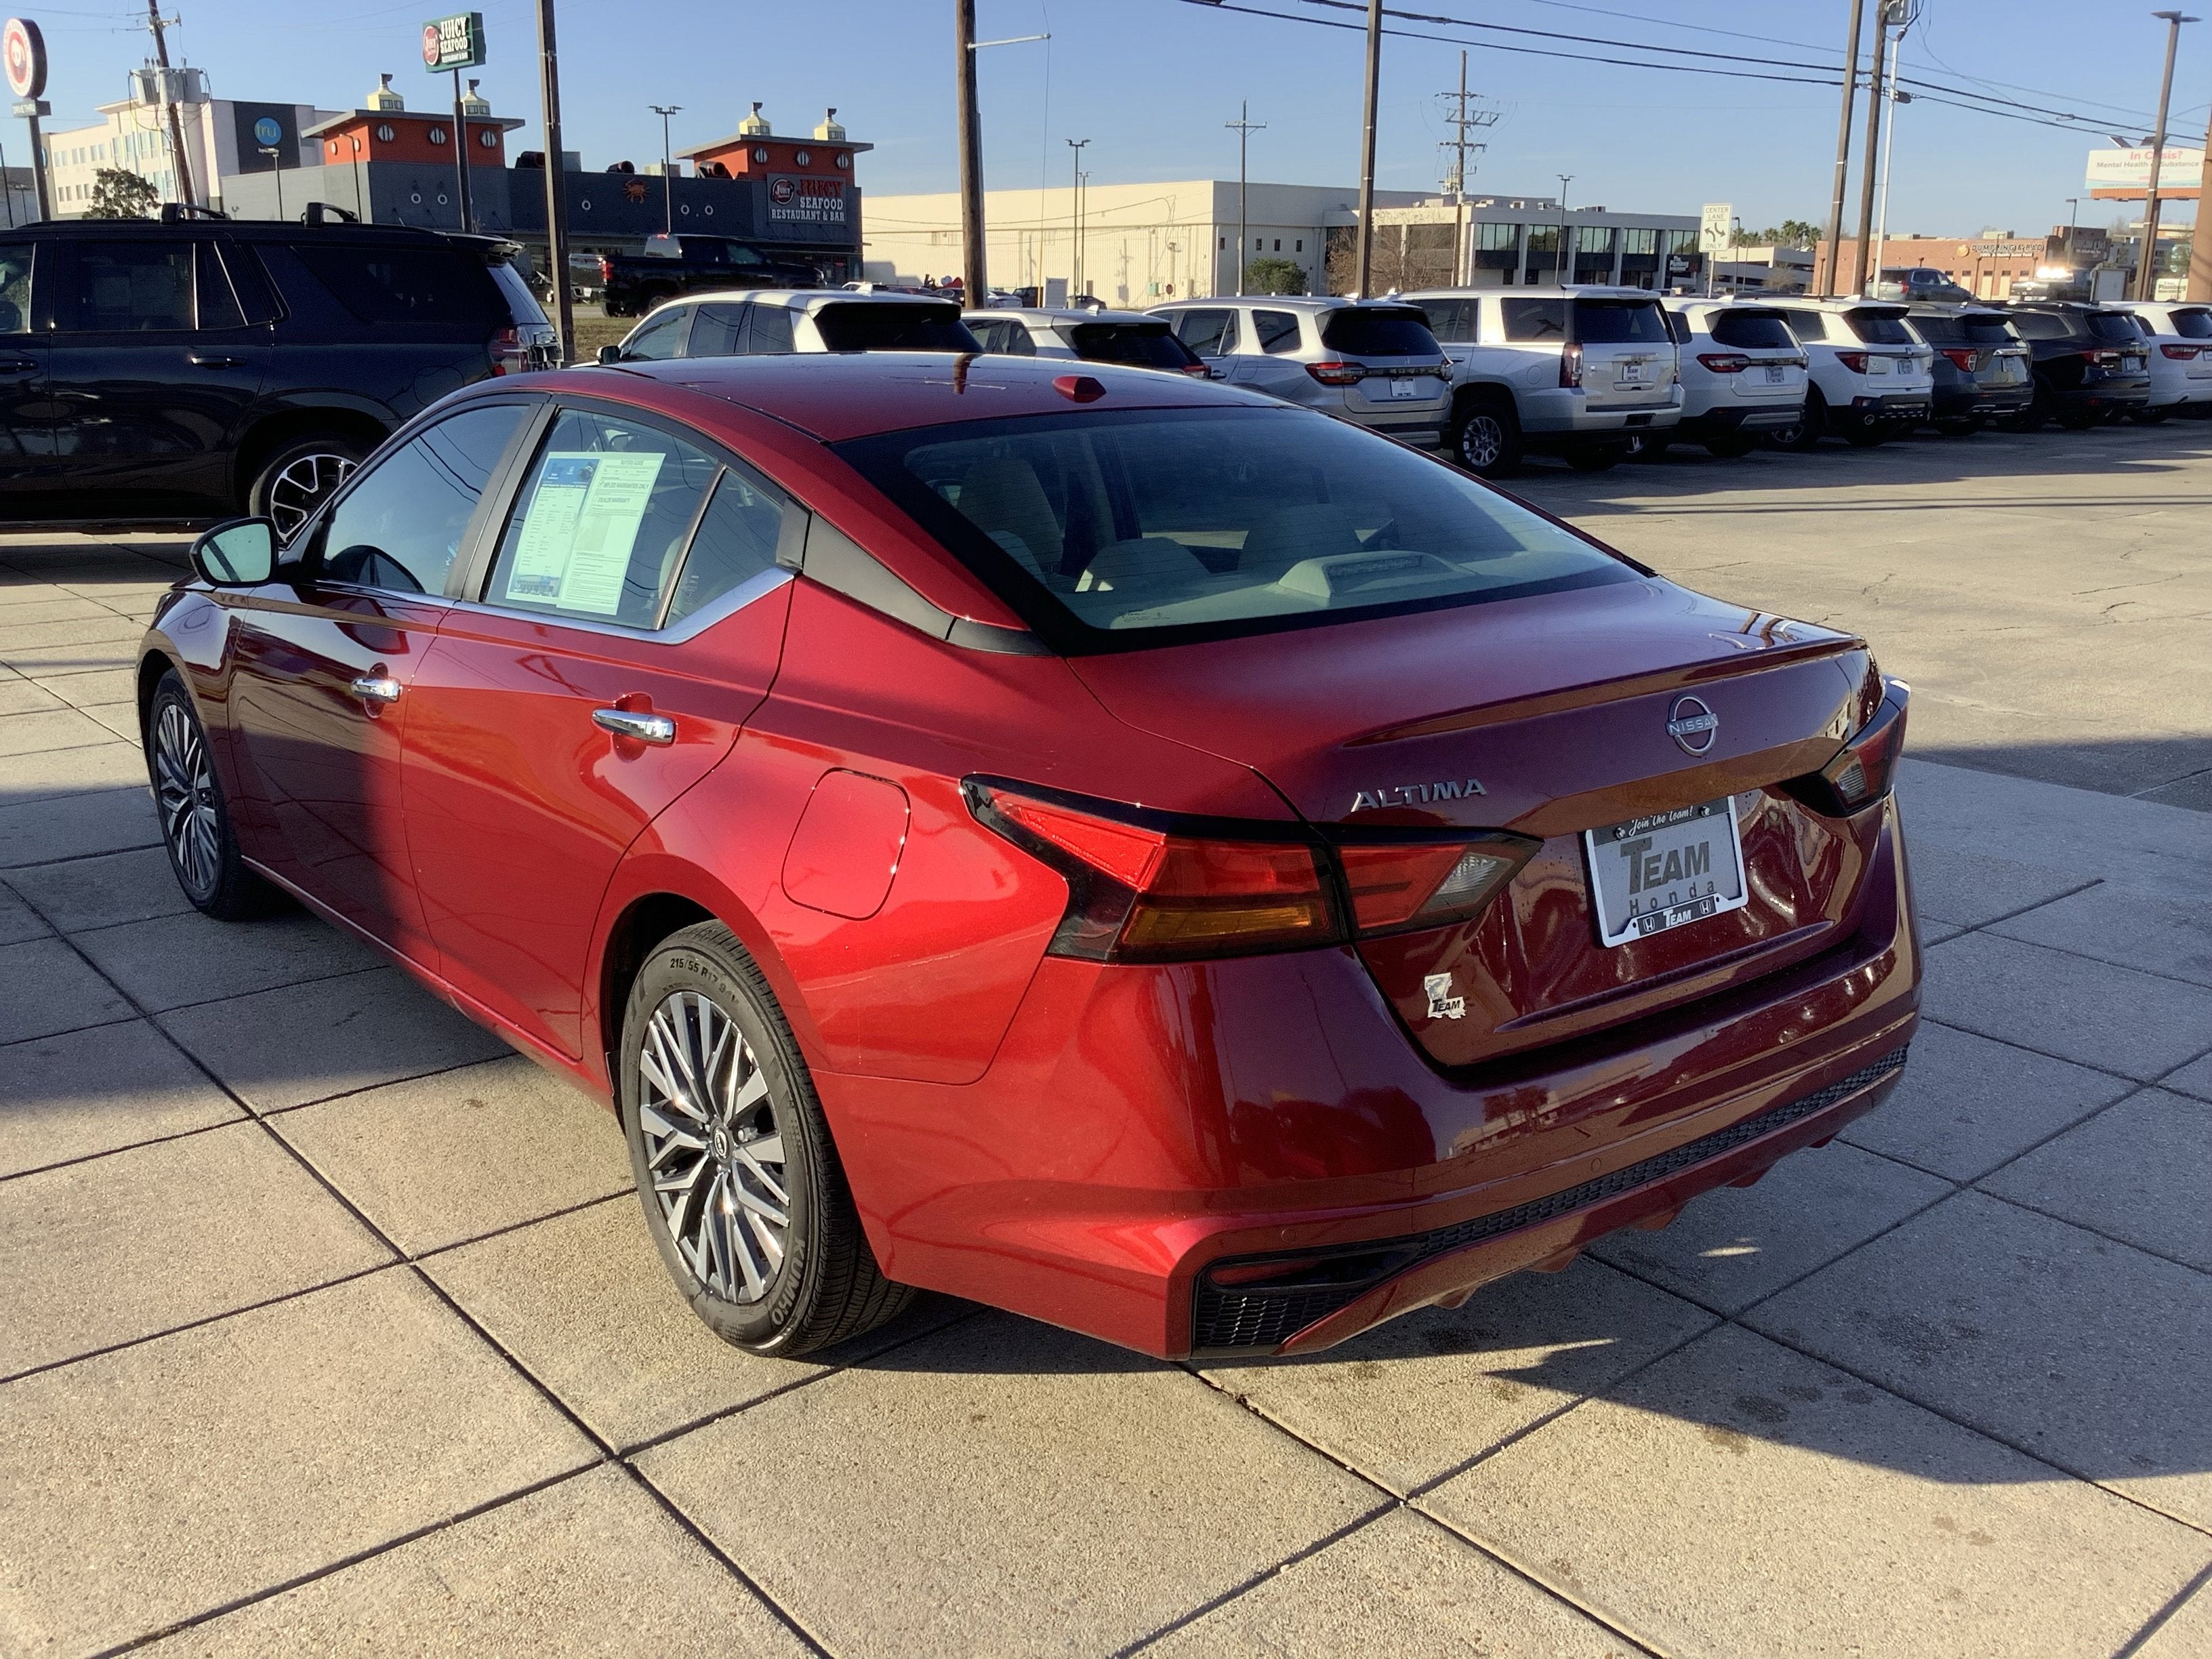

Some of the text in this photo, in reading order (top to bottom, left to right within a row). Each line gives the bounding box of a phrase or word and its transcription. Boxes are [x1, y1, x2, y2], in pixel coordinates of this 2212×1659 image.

[439, 17, 466, 41] JUICY
[440, 36, 468, 54] SEAFOOD
[2130, 150, 2183, 160] In Csis?
[800, 197, 843, 210] SEAFOOD
[771, 209, 844, 222] RESTAURANT & BAR
[1668, 716, 1718, 733] NISSAN
[1351, 779, 1488, 813] ALTIMA
[1629, 817, 1650, 836] Join
[1620, 836, 1709, 895] TEAM
[1629, 881, 1715, 916] Honda
[1663, 909, 1692, 927] TEAM
[670, 958, 700, 973] 215/55
[1432, 998, 1460, 1012] TEAM
[772, 1236, 806, 1326] KUMHO
